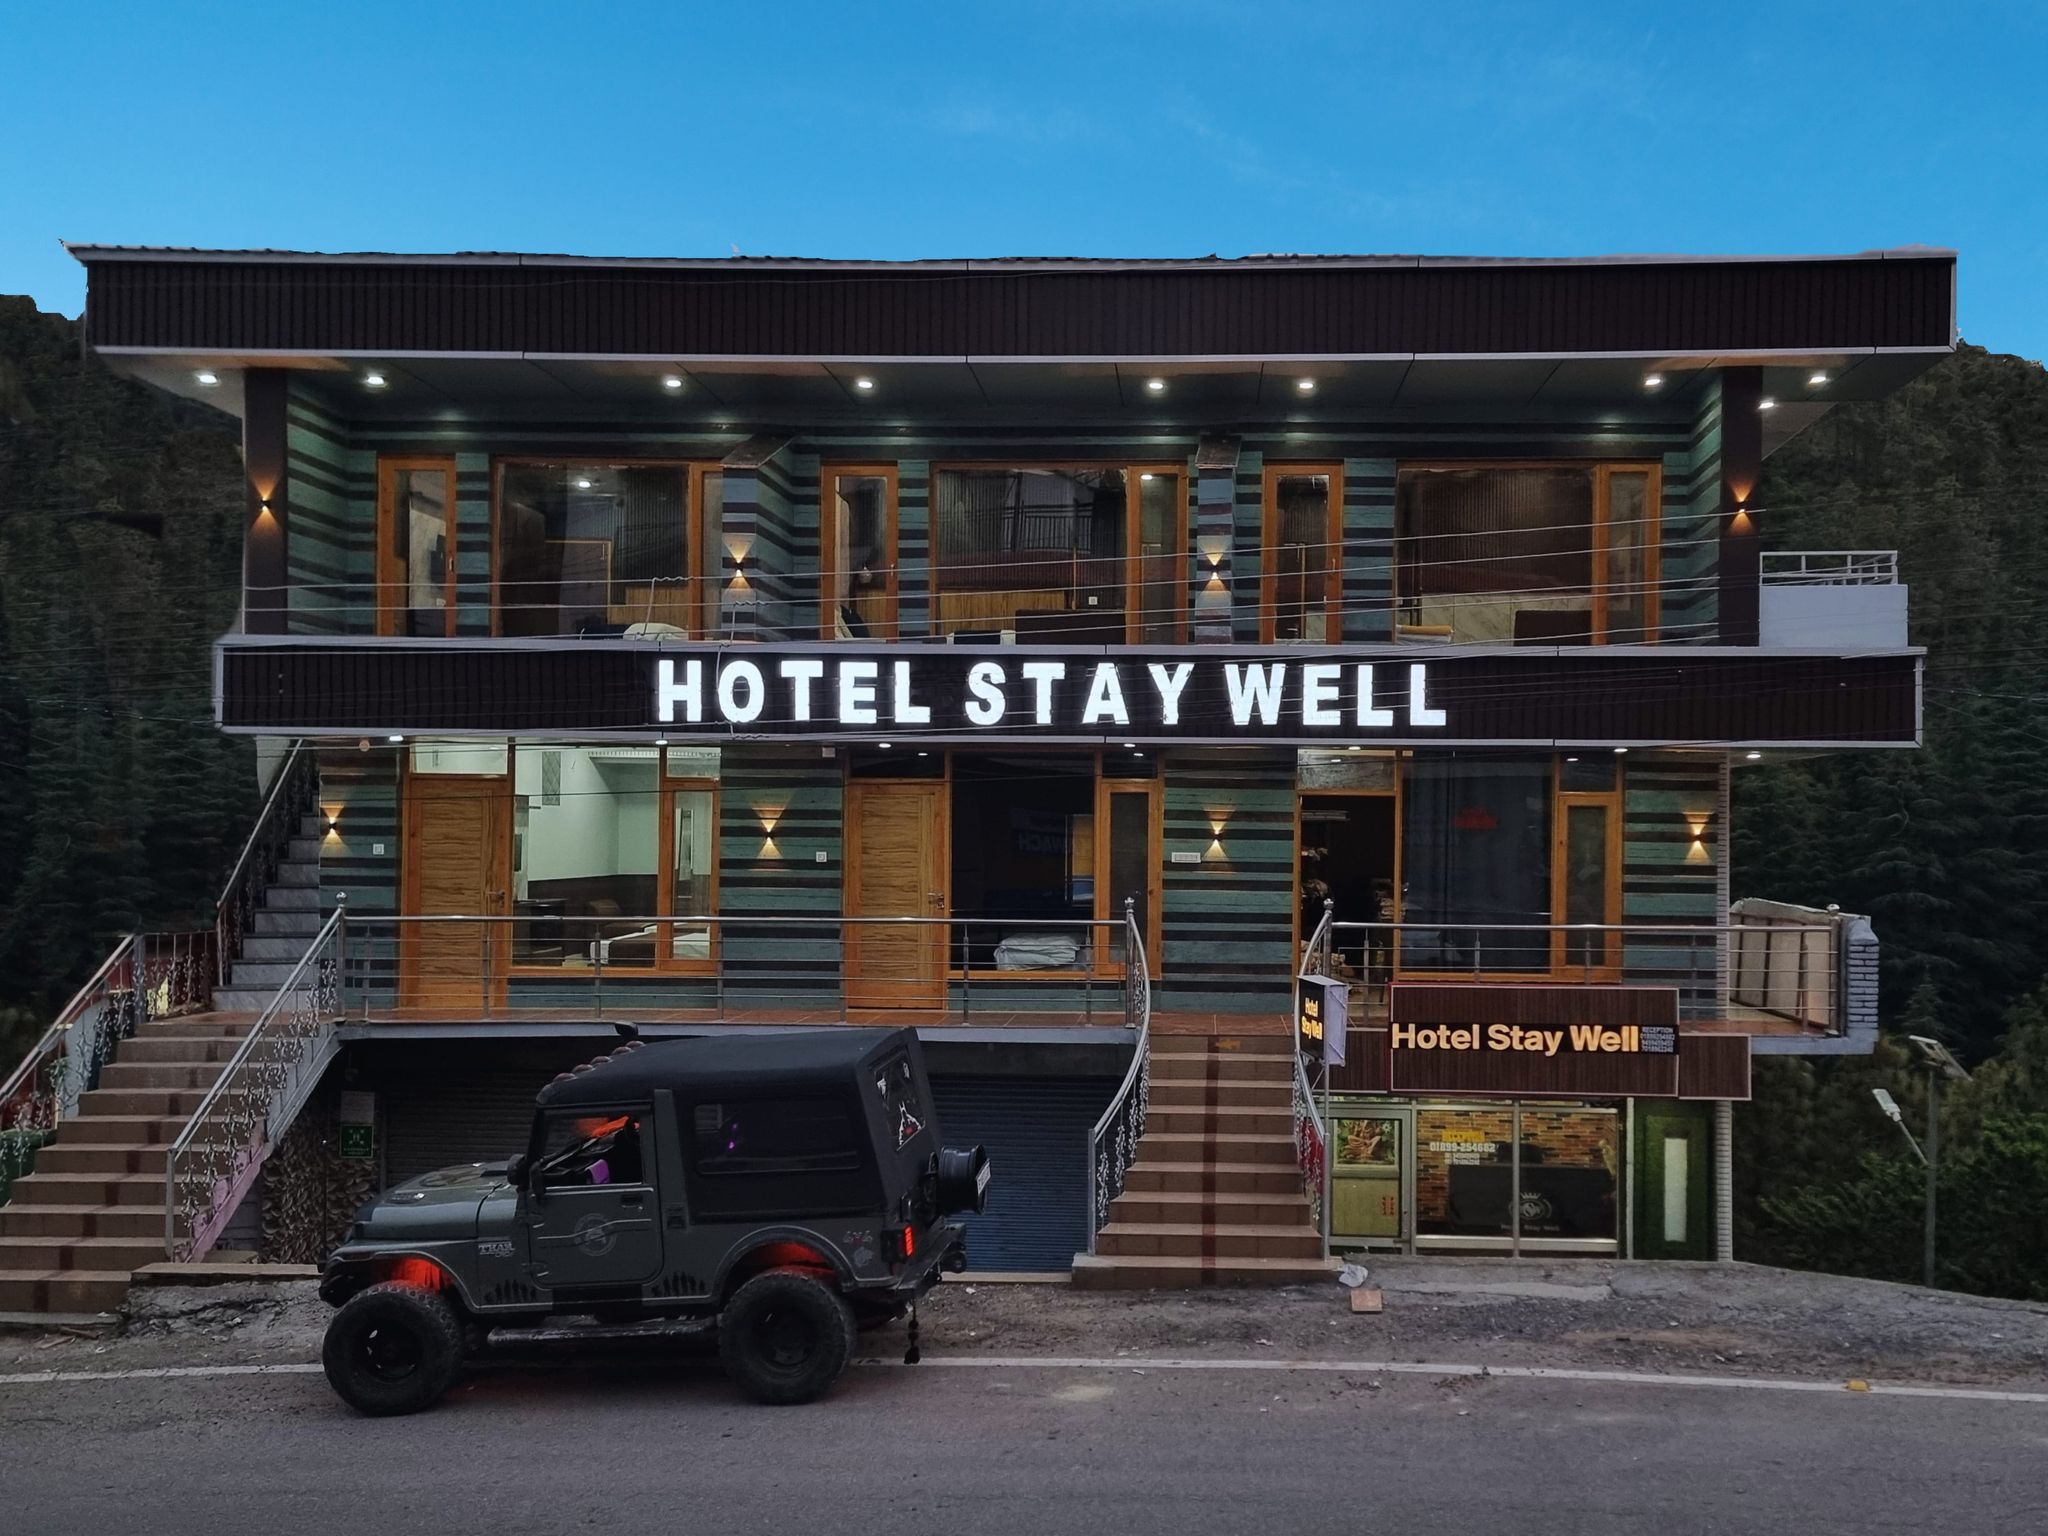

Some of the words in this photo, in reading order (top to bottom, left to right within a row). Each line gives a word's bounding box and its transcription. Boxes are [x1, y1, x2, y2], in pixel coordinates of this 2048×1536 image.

[657, 660, 930, 724] HOTEL
[965, 661, 1195, 727] STAY
[1225, 664, 1447, 727] WELL
[1304, 997, 1319, 1017] Hotel
[1301, 1015, 1312, 1040] Stay
[1311, 1019, 1323, 1041] Well
[1391, 1023, 1479, 1050] Hotel
[1487, 1024, 1563, 1057] Stay
[1569, 1025, 1639, 1052] Well
